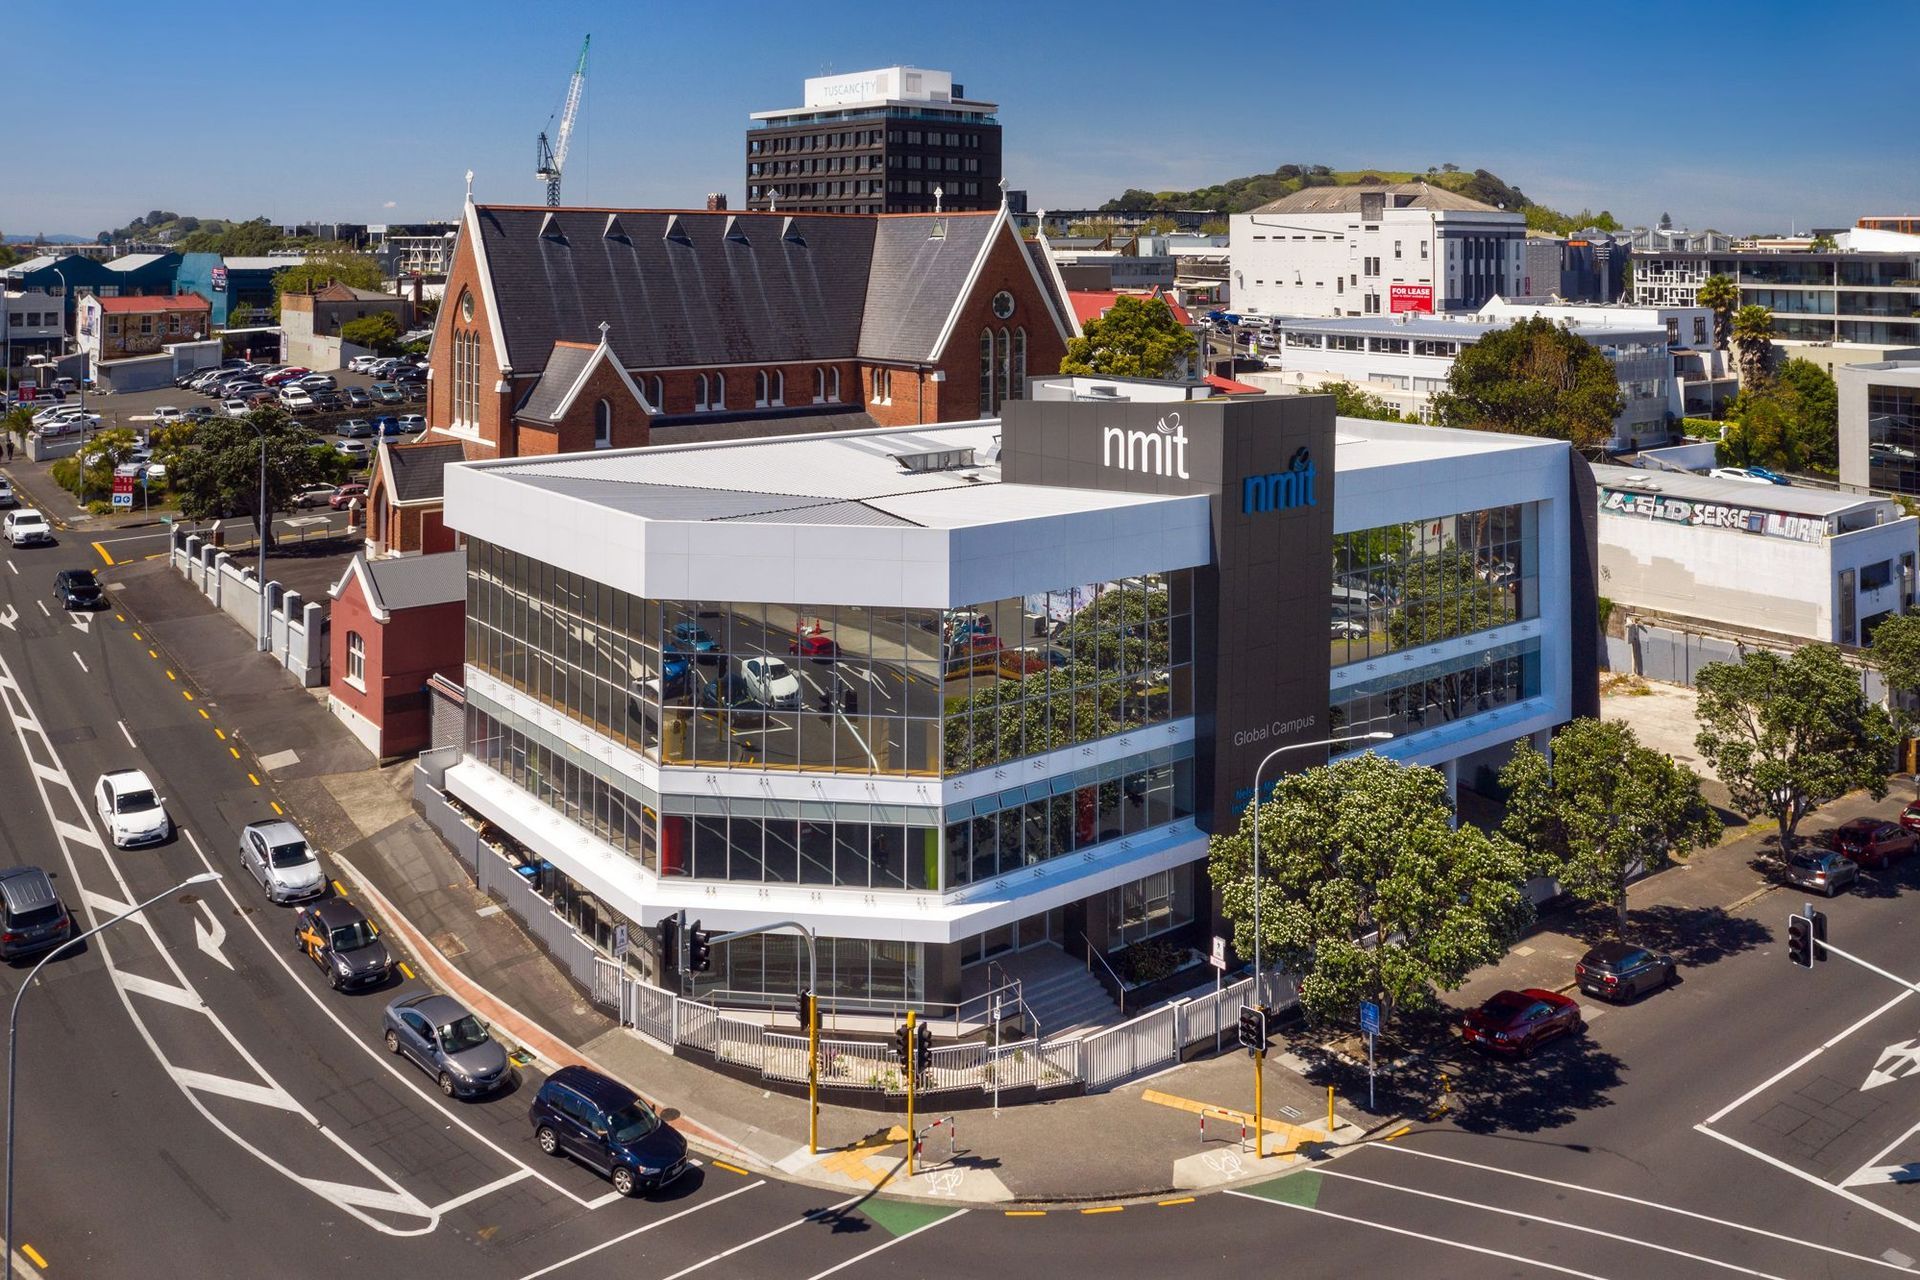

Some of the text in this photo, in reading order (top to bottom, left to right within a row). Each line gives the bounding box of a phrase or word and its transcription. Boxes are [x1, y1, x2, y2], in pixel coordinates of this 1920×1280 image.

[1392, 287, 1406, 295] FOR
[1407, 288, 1430, 296] LEASE
[1104, 424, 1190, 480] nmit
[1242, 459, 1318, 516] nmit
[1692, 503, 1750, 529] SERGE
[1233, 714, 1316, 746] Global Campus
